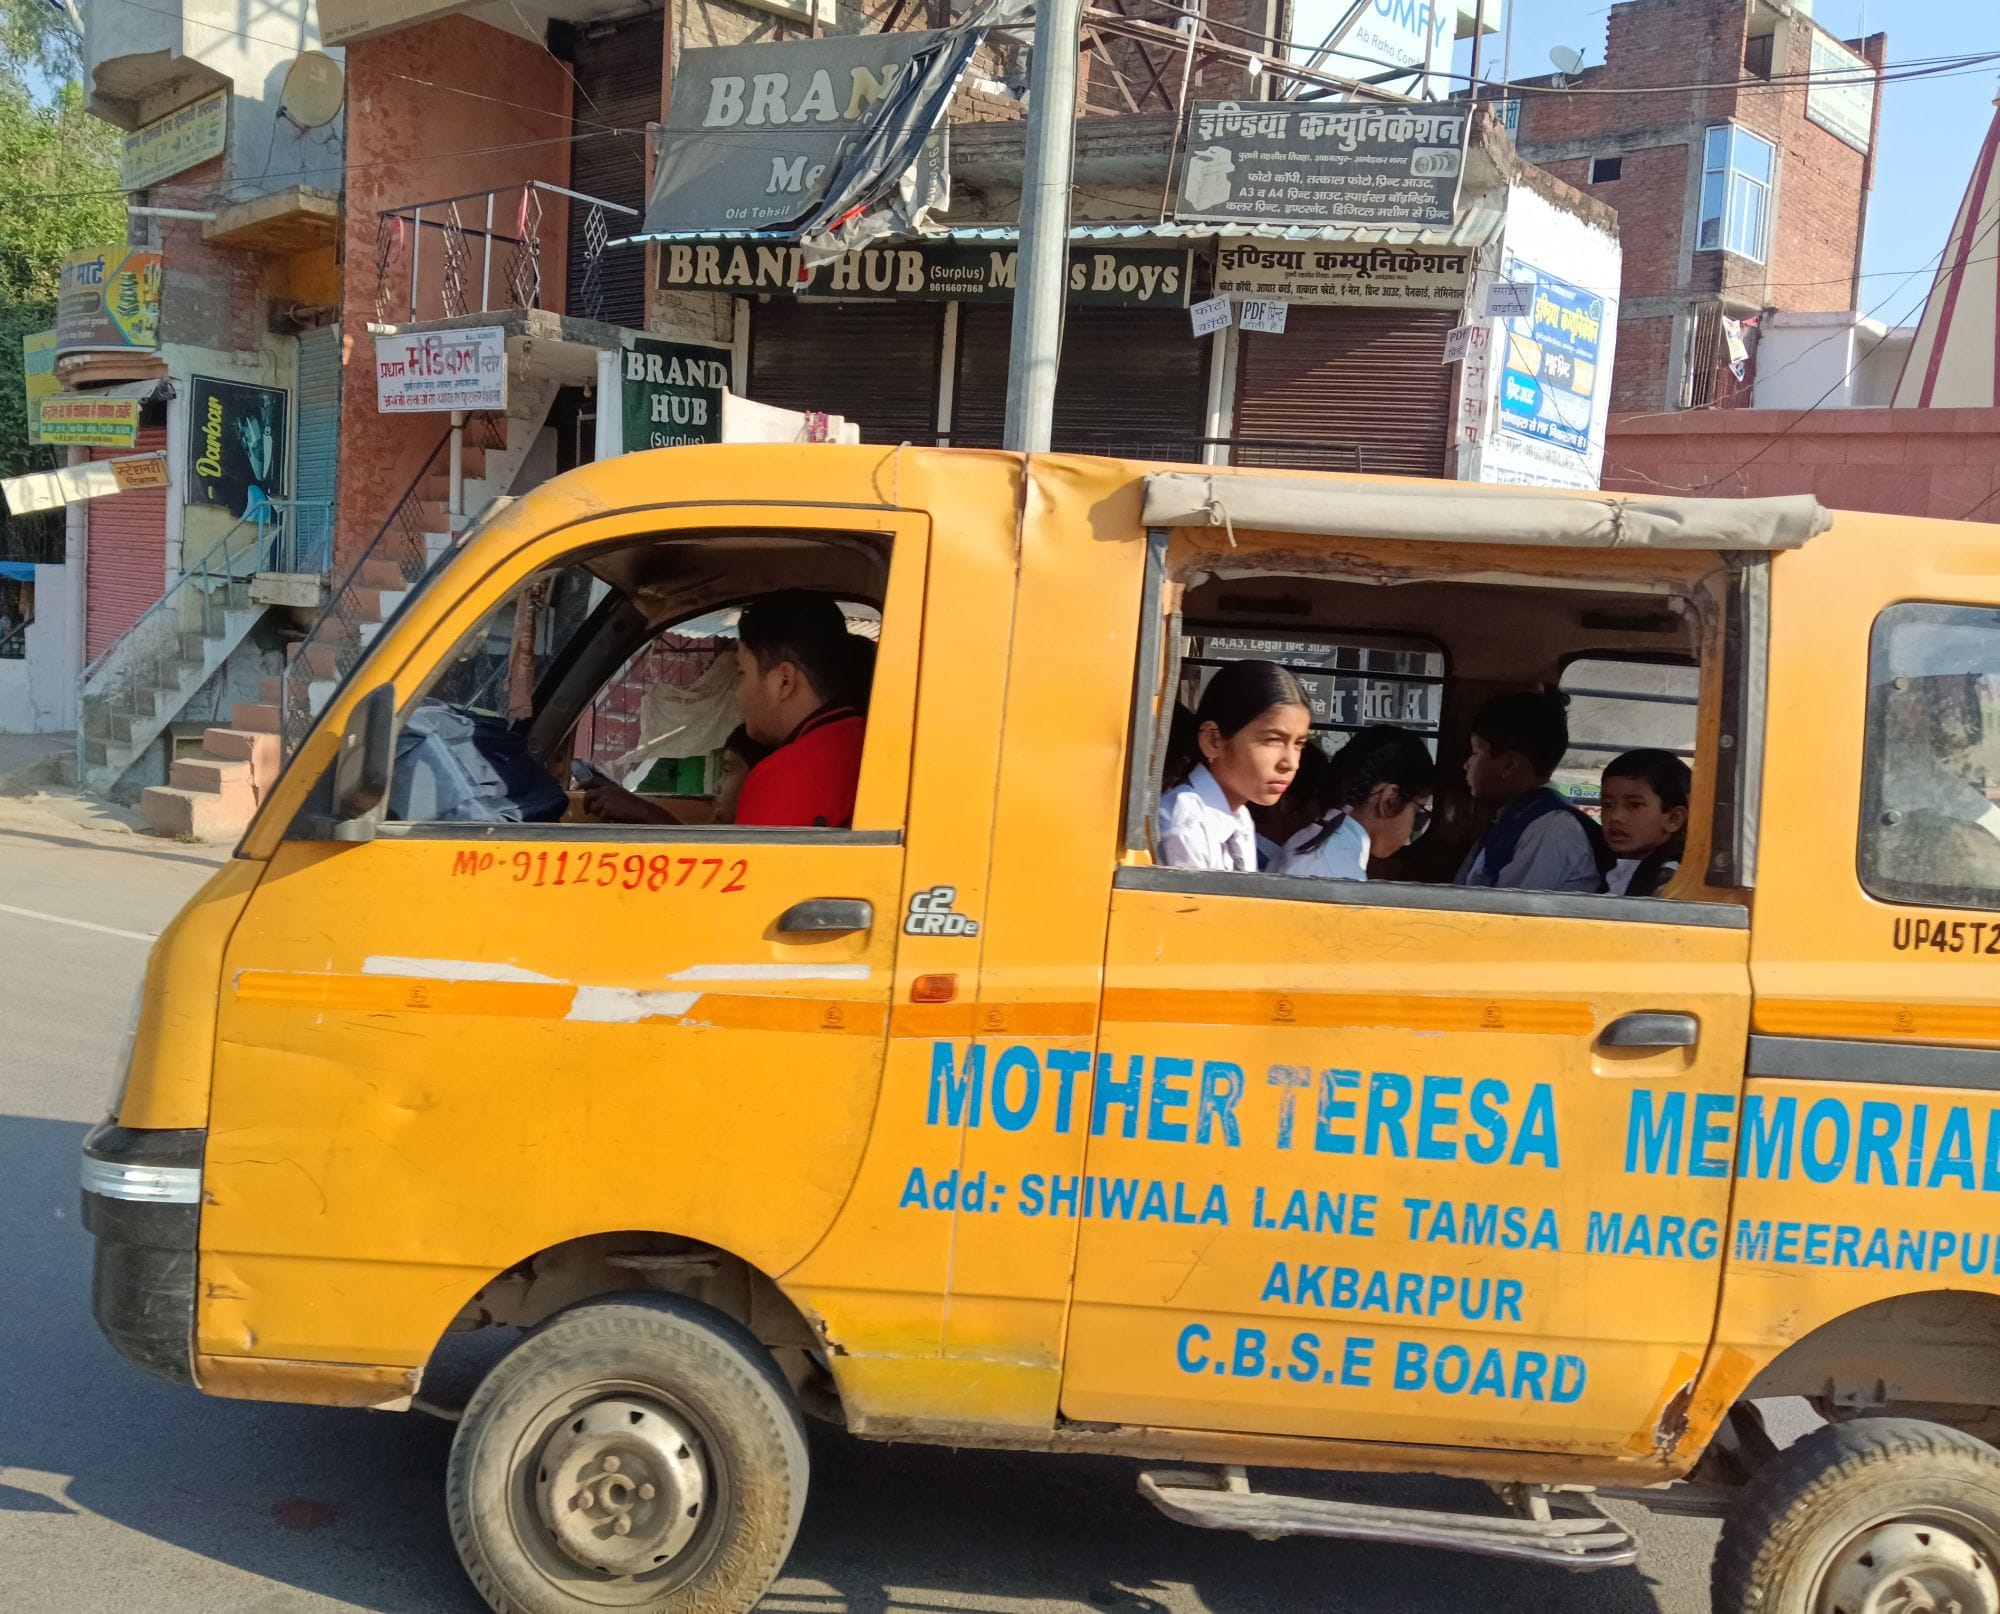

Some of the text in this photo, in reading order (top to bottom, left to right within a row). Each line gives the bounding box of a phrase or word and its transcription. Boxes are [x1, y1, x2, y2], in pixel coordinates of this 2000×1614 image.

[1371, 34, 1395, 57] Raho
[702, 68, 899, 127] BRAN
[1198, 101, 1292, 141] इण्डिया
[1239, 187, 1255, 197] A3
[1257, 188, 1265, 197] व
[1268, 188, 1284, 198] A4
[1287, 187, 1311, 200] प्रिन्ट
[1248, 171, 1272, 183] फोटो
[1306, 175, 1345, 185] तत्काल
[1402, 178, 1434, 189] आउट,
[725, 206, 790, 219] Old Tehsil
[1226, 202, 1253, 212] कलर
[1333, 203, 1374, 217] डिजिटल
[1377, 206, 1410, 218] मशीन
[1412, 207, 1423, 218] से
[1425, 207, 1450, 220] प्रिन्ट
[830, 250, 926, 292] HUB
[930, 266, 985, 280] (Surplus)
[1091, 254, 1180, 300] Boys
[1220, 243, 1468, 279] इण्डिया कम्यूनिकेशन
[929, 283, 984, 293] 9616607868
[1243, 301, 1266, 320] PDF
[1449, 330, 1470, 343] PDF
[379, 361, 405, 379] प्रधान
[405, 335, 481, 377] मेडिकल
[626, 352, 728, 390] BRAND
[651, 393, 708, 426] HUB
[1250, 640, 1282, 652] Legal
[904, 913, 979, 937] CRDe
[926, 1041, 1244, 1148] MOTHER
[1265, 1065, 1560, 1169] TERESA
[900, 1166, 2000, 1275] Add: SHIWALA LANE TAMSA MARG MEERANPU
[1260, 1262, 1524, 1323] AKBARPUR
[1177, 1323, 1588, 1404] C.B.S.E BOARD
